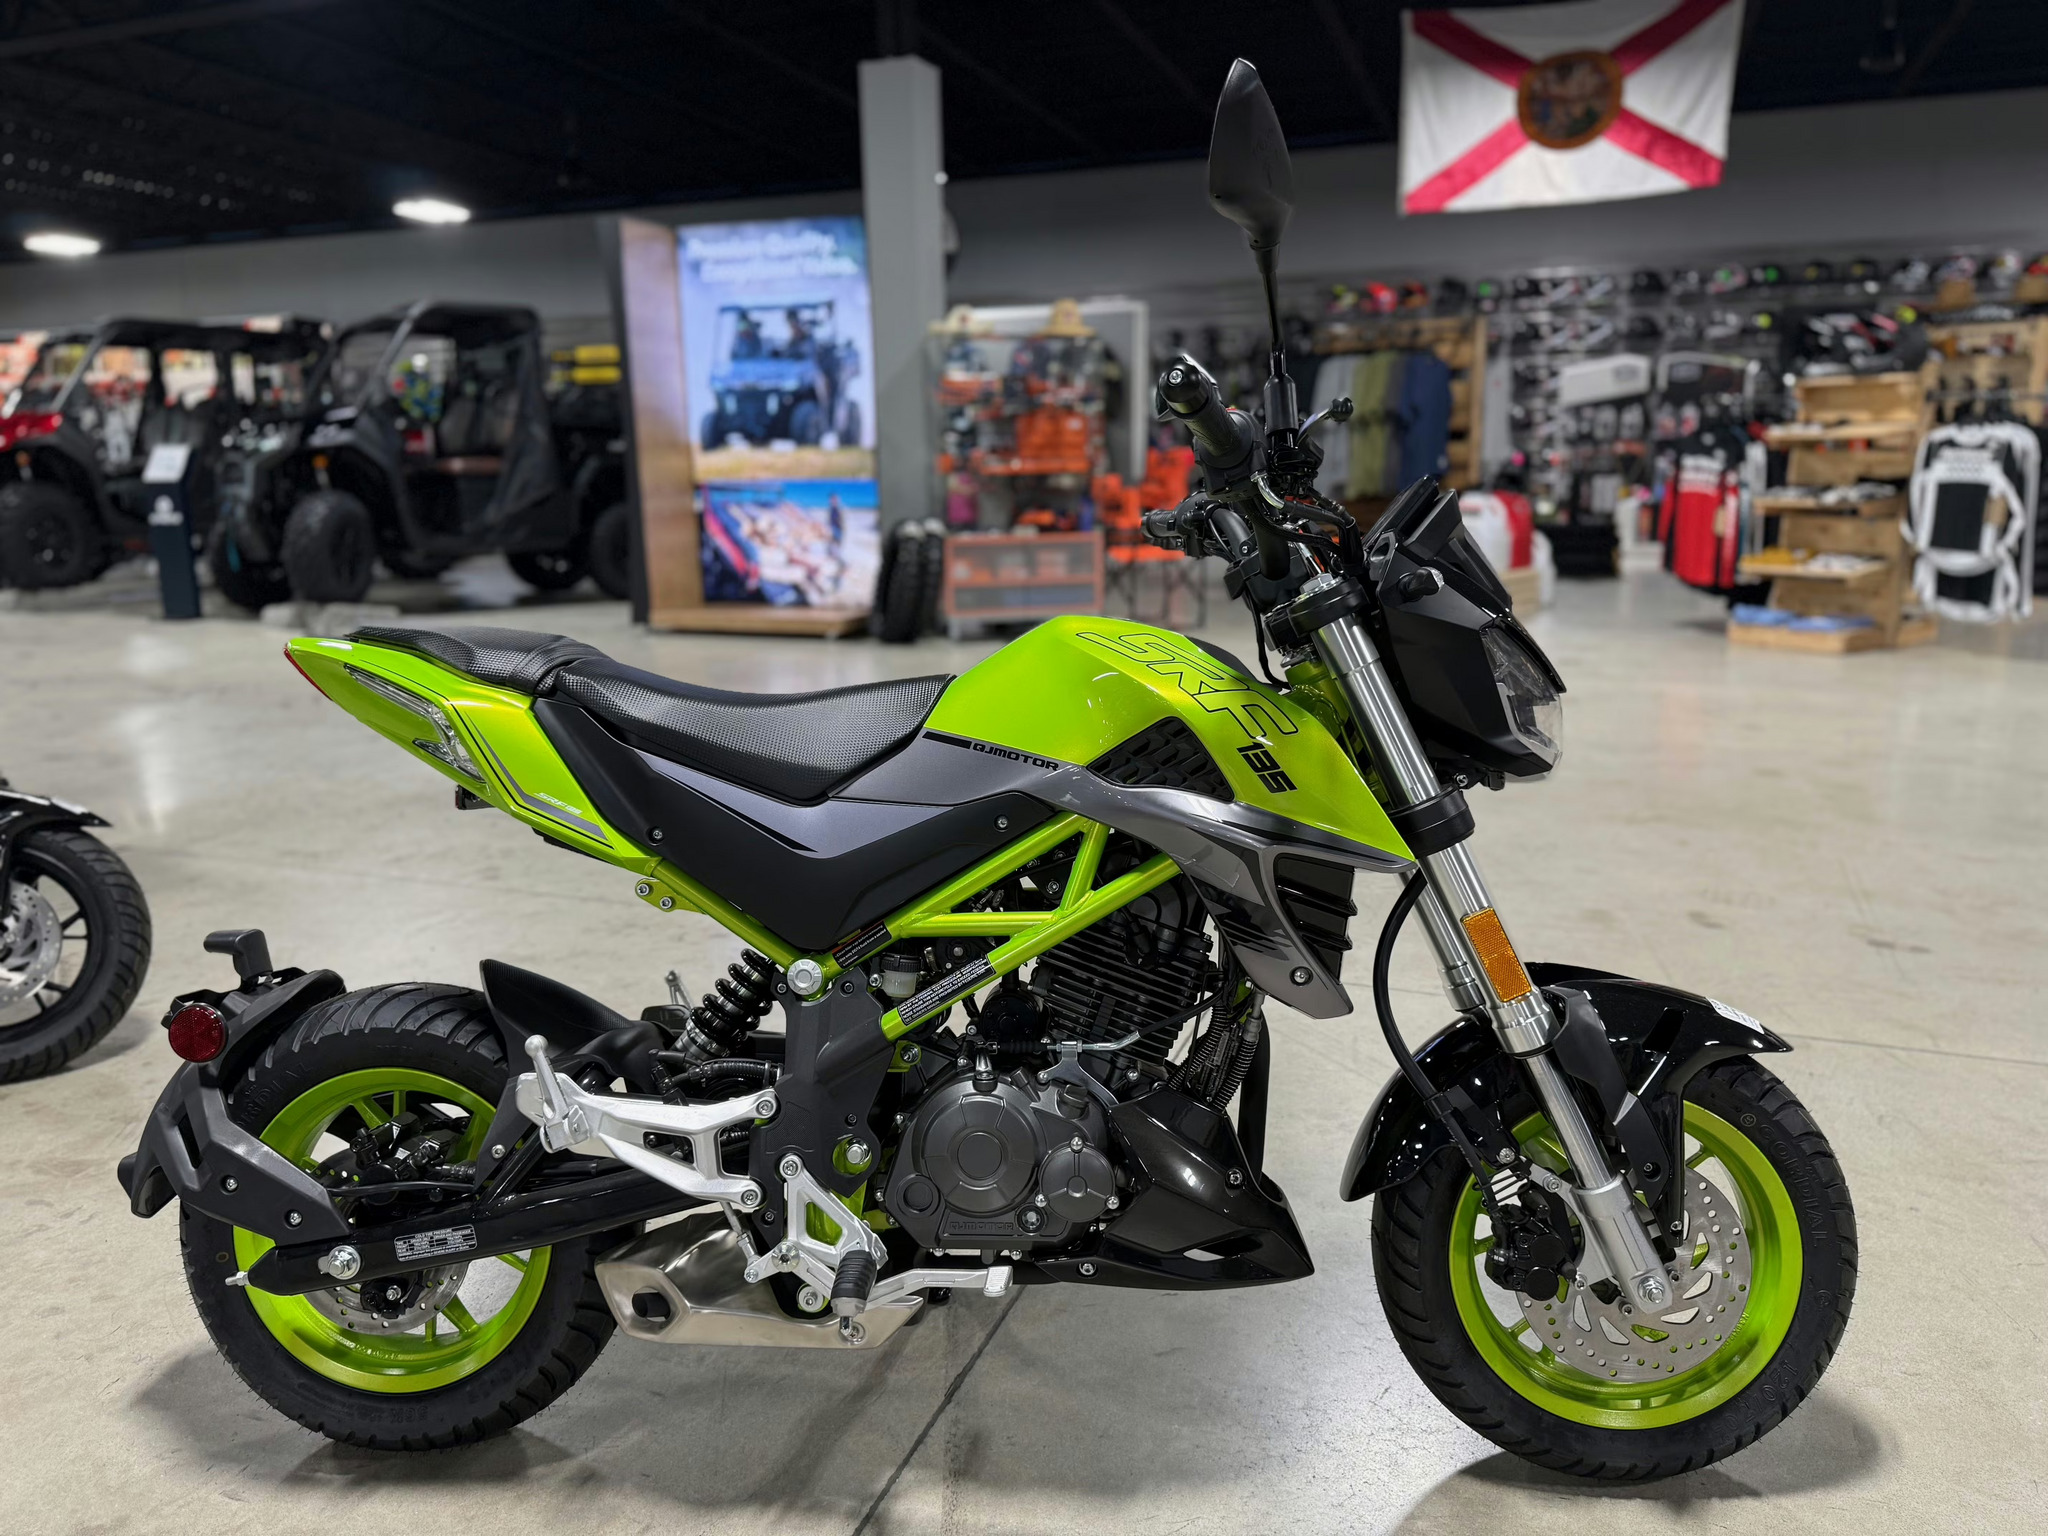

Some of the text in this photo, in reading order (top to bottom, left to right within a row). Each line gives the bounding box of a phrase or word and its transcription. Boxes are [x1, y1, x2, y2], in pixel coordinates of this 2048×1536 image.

[1075, 632, 1307, 793] SRF 135
[972, 742, 1059, 772] QJMOTOR
[949, 1221, 1015, 1232] QJMOTOR
